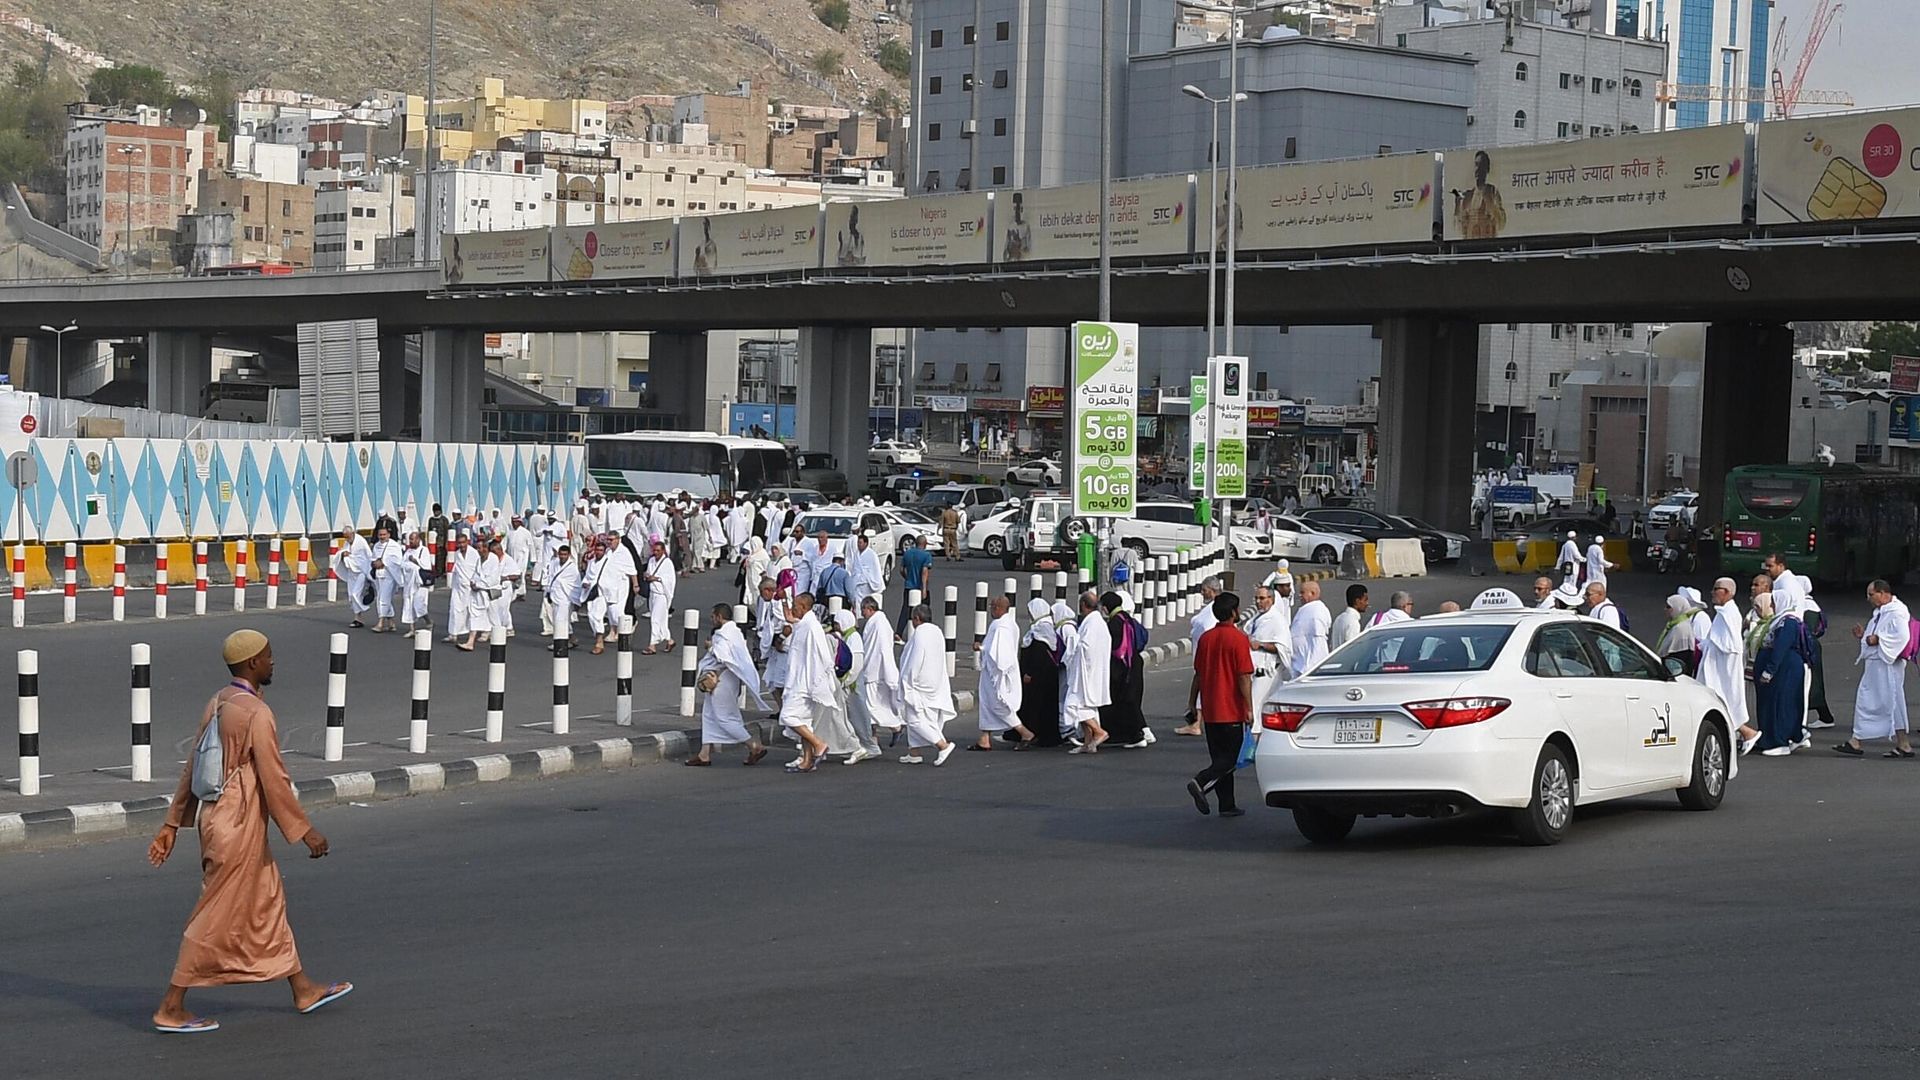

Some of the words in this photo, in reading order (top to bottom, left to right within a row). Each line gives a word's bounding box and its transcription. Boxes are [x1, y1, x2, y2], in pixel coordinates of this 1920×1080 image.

[1870, 146, 1881, 156] SR
[1883, 145, 1894, 156] 30
[1512, 171, 1539, 188] भारत
[1544, 164, 1576, 186] आपसे
[1582, 165, 1615, 181] ज्यादा
[1621, 158, 1650, 178] करीब
[1694, 165, 1720, 180] STC
[1326, 182, 1338, 205] آپ
[1342, 182, 1373, 202] پاکستان
[1393, 190, 1414, 202] STC
[1109, 193, 1139, 210] alaysia
[921, 208, 947, 222] Nigeria
[1039, 212, 1060, 228] lebih
[1061, 211, 1083, 226] dekat
[1153, 208, 1170, 219] STC
[899, 226, 921, 238] closer
[923, 226, 931, 237] to
[959, 222, 974, 232] STC
[795, 230, 807, 240] STC
[1081, 331, 1111, 351] زين
[1082, 384, 1107, 395] الحج
[1110, 383, 1133, 396] باقة
[1088, 394, 1129, 406] والعمرة
[1086, 416, 1101, 439] 5
[1104, 426, 1127, 439] GB
[1087, 445, 1108, 453] يوم
[1110, 441, 1125, 451] 30
[1082, 475, 1108, 494] 10
[1110, 484, 1129, 494] GB
[1088, 501, 1110, 509] يوم
[1111, 497, 1127, 508] 90
[1337, 732, 1356, 741] 9106
